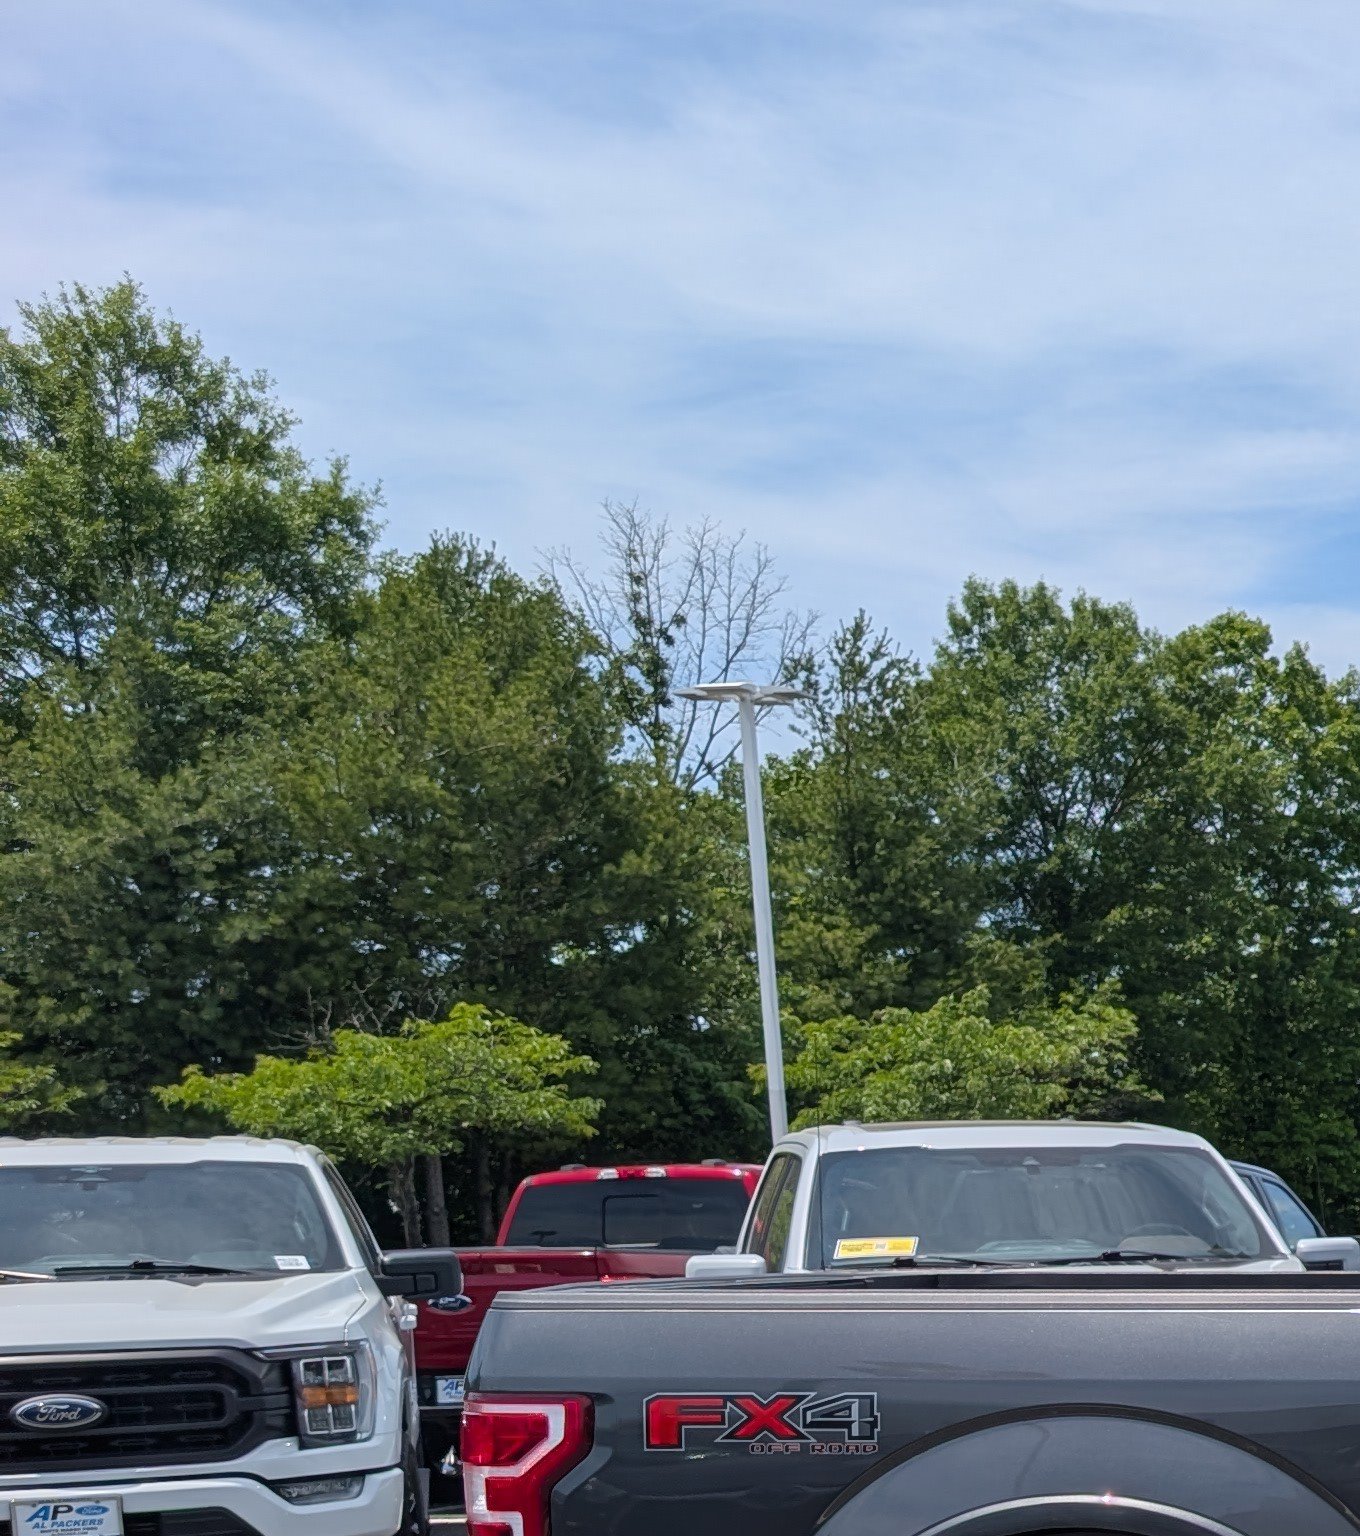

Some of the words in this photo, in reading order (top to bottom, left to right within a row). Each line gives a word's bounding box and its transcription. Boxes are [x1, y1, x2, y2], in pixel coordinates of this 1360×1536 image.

[36, 1404, 81, 1421] Ford
[643, 1392, 880, 1451] FX4
[749, 1443, 801, 1455] OFF
[810, 1443, 879, 1455] ROAD
[25, 1504, 73, 1522] AP
[32, 1521, 47, 1530] AL
[51, 1518, 104, 1528] PACKERS
